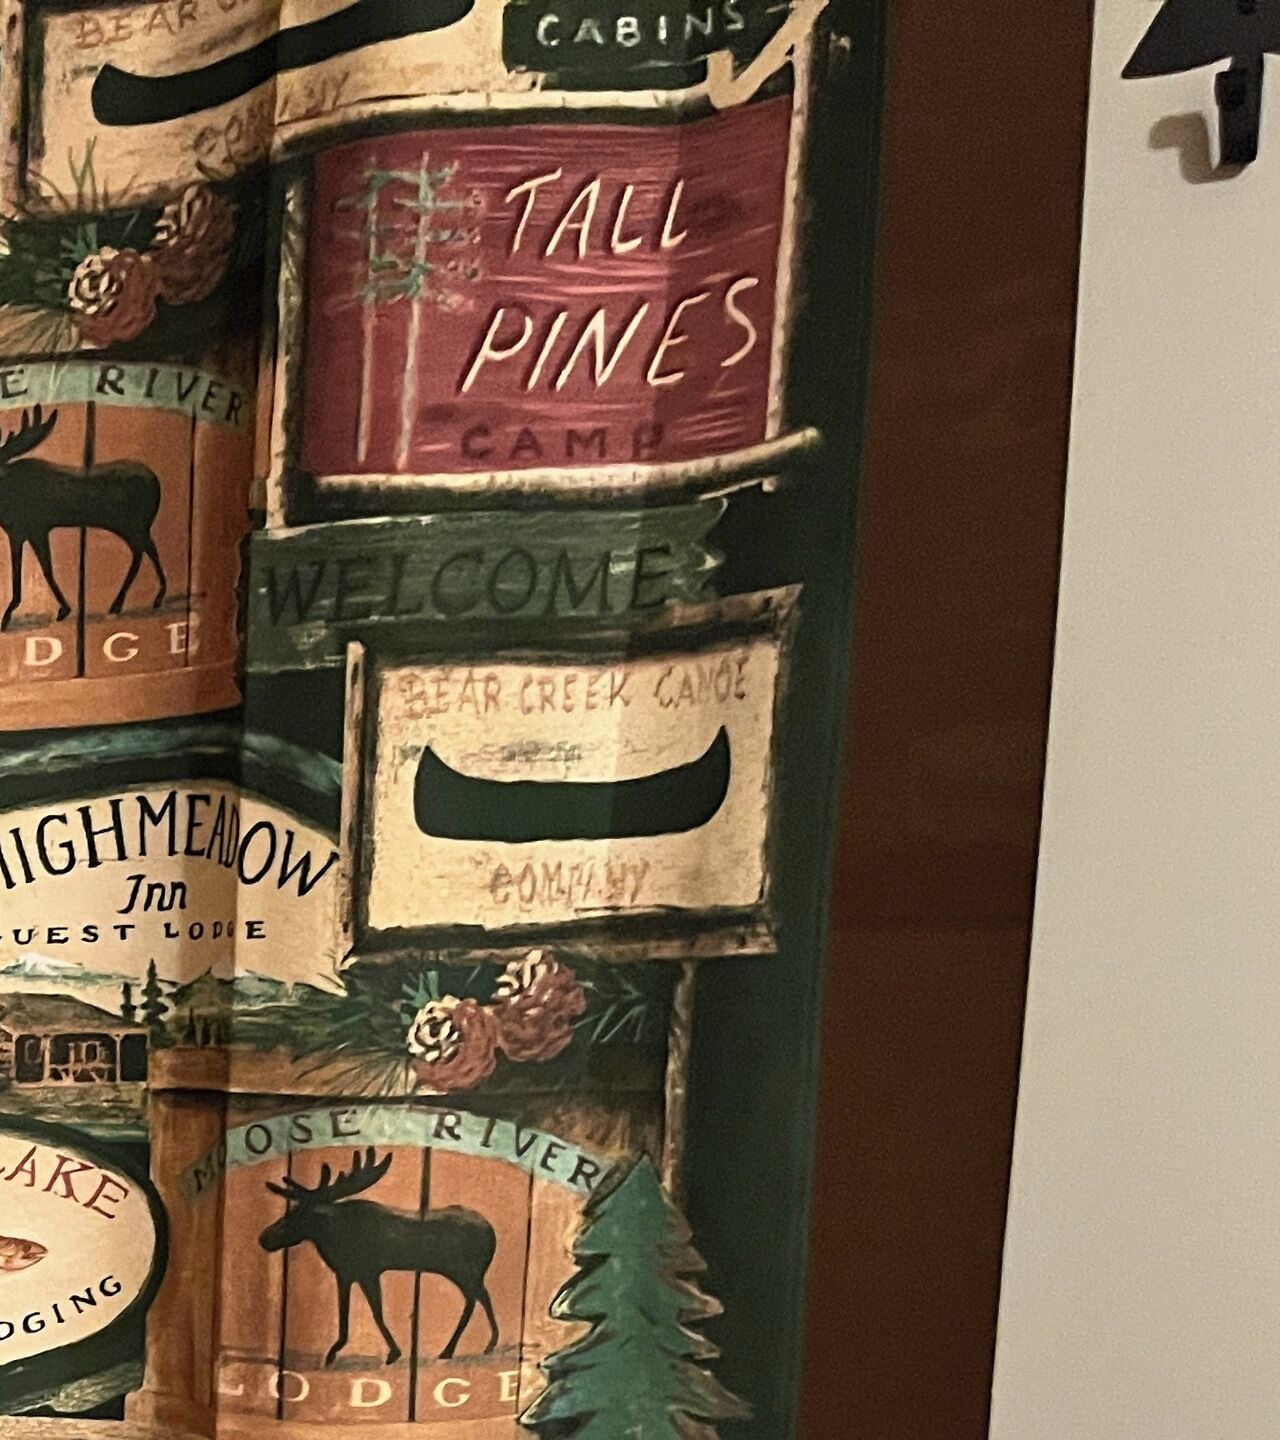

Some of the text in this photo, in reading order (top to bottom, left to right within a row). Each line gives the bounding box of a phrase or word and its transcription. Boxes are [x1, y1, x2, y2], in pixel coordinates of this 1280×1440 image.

[535, 0, 746, 48] CABINS
[504, 167, 689, 260] TALL
[459, 277, 760, 394] PINES
[94, 363, 244, 427] RIVER
[459, 423, 665, 461] CAMP
[259, 541, 678, 628] WELCOME
[397, 655, 748, 721] BEAR CREEK CANOE
[118, 874, 189, 915] Inn
[163, 918, 268, 942] LODGE
[432, 1108, 603, 1190] RIVER
